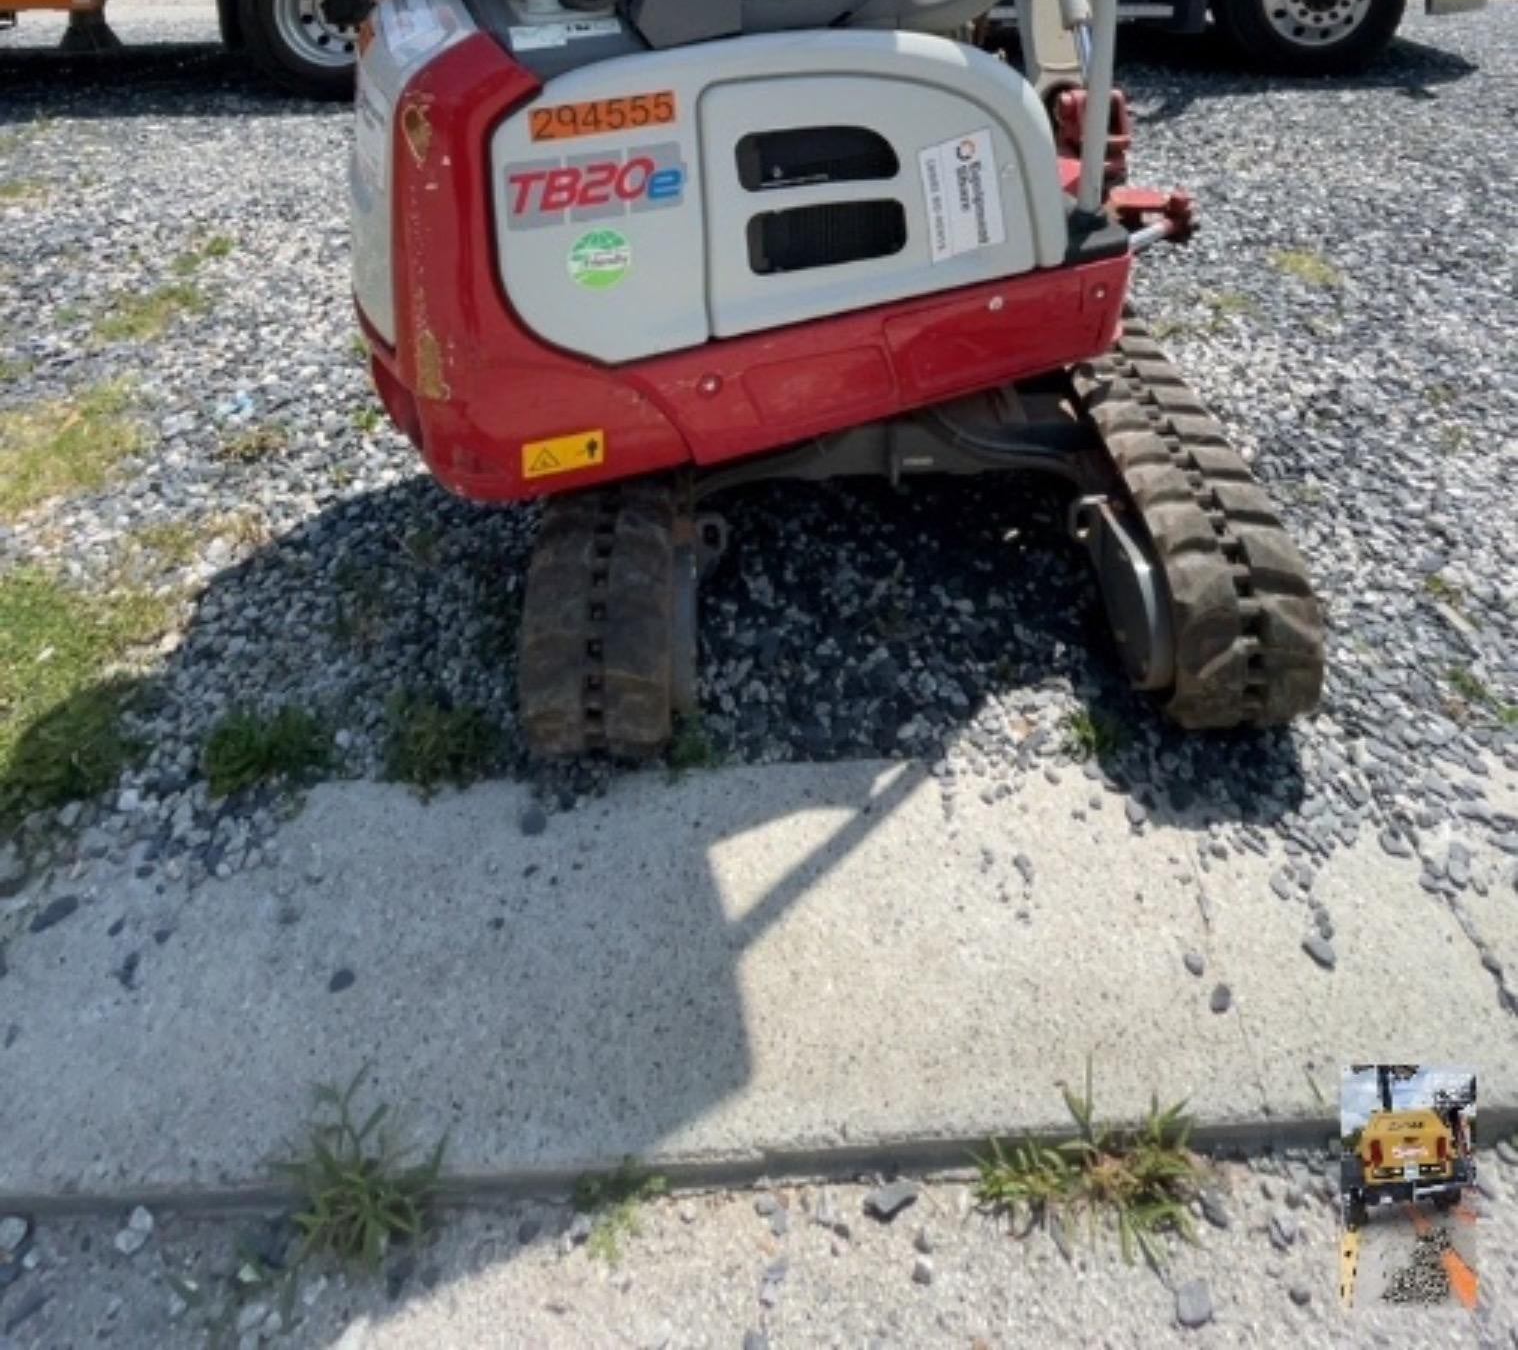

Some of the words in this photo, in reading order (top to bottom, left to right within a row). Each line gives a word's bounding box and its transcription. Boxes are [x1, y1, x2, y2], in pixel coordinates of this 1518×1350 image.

[531, 91, 675, 140] 294555
[508, 156, 682, 215] TB20e
[956, 164, 971, 213] Share
[968, 160, 991, 244] Equipment
